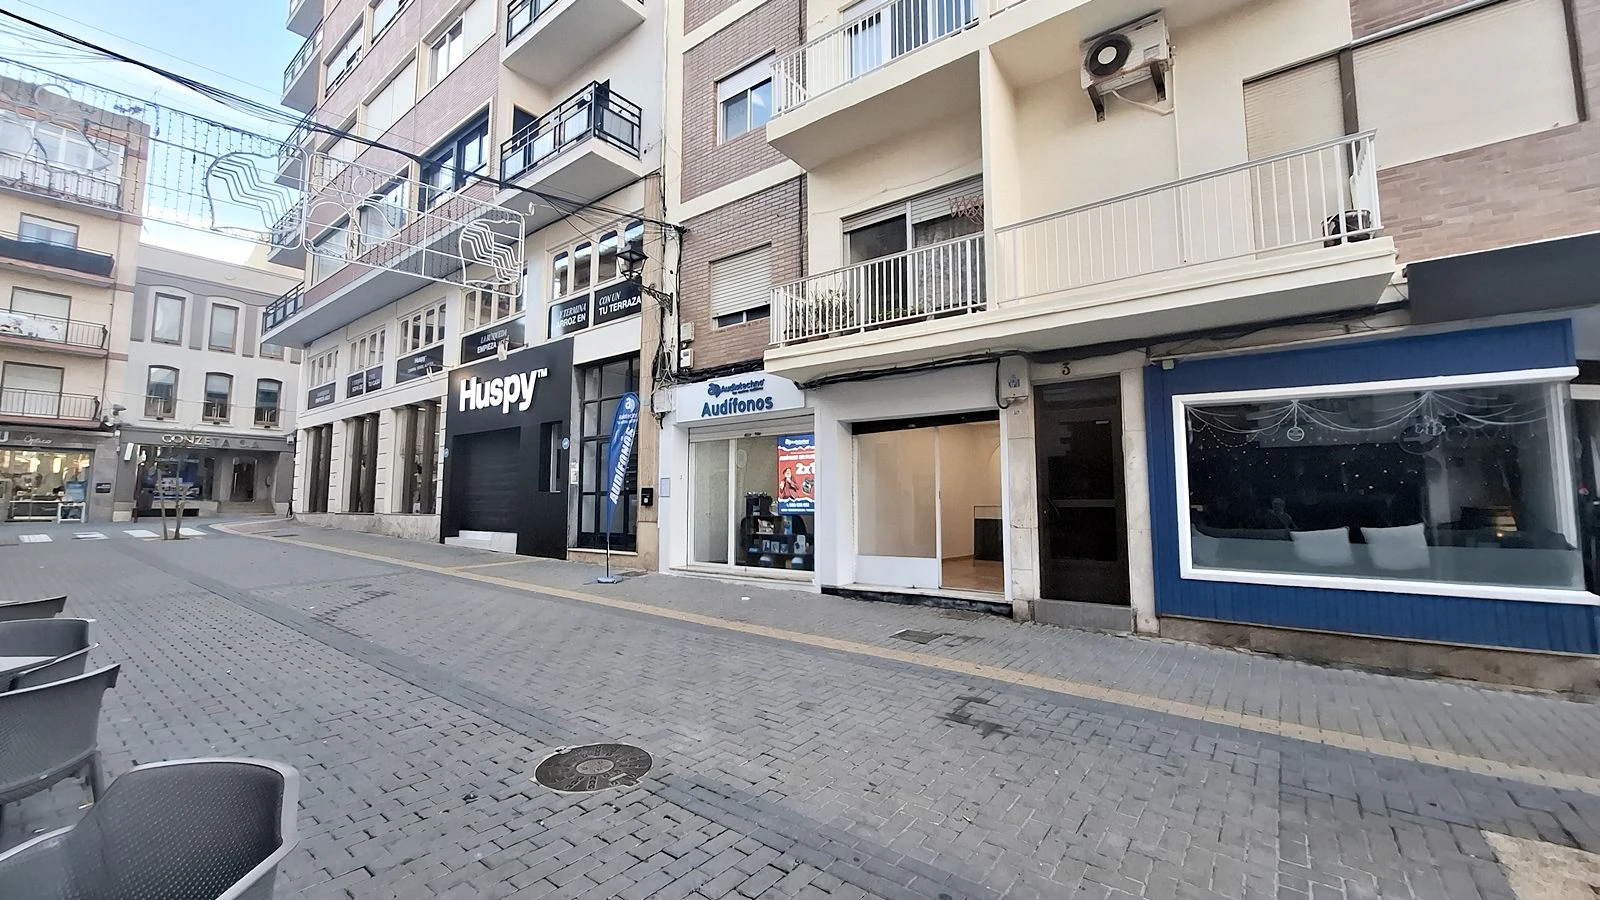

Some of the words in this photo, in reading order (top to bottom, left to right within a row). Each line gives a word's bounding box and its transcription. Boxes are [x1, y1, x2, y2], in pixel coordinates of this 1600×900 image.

[599, 306, 608, 316] TU
[609, 295, 641, 313] TERRAZA
[577, 313, 586, 321] EN
[1062, 362, 1070, 375] 3
[701, 396, 774, 417] Audífonos
[161, 433, 231, 448] CONZETA
